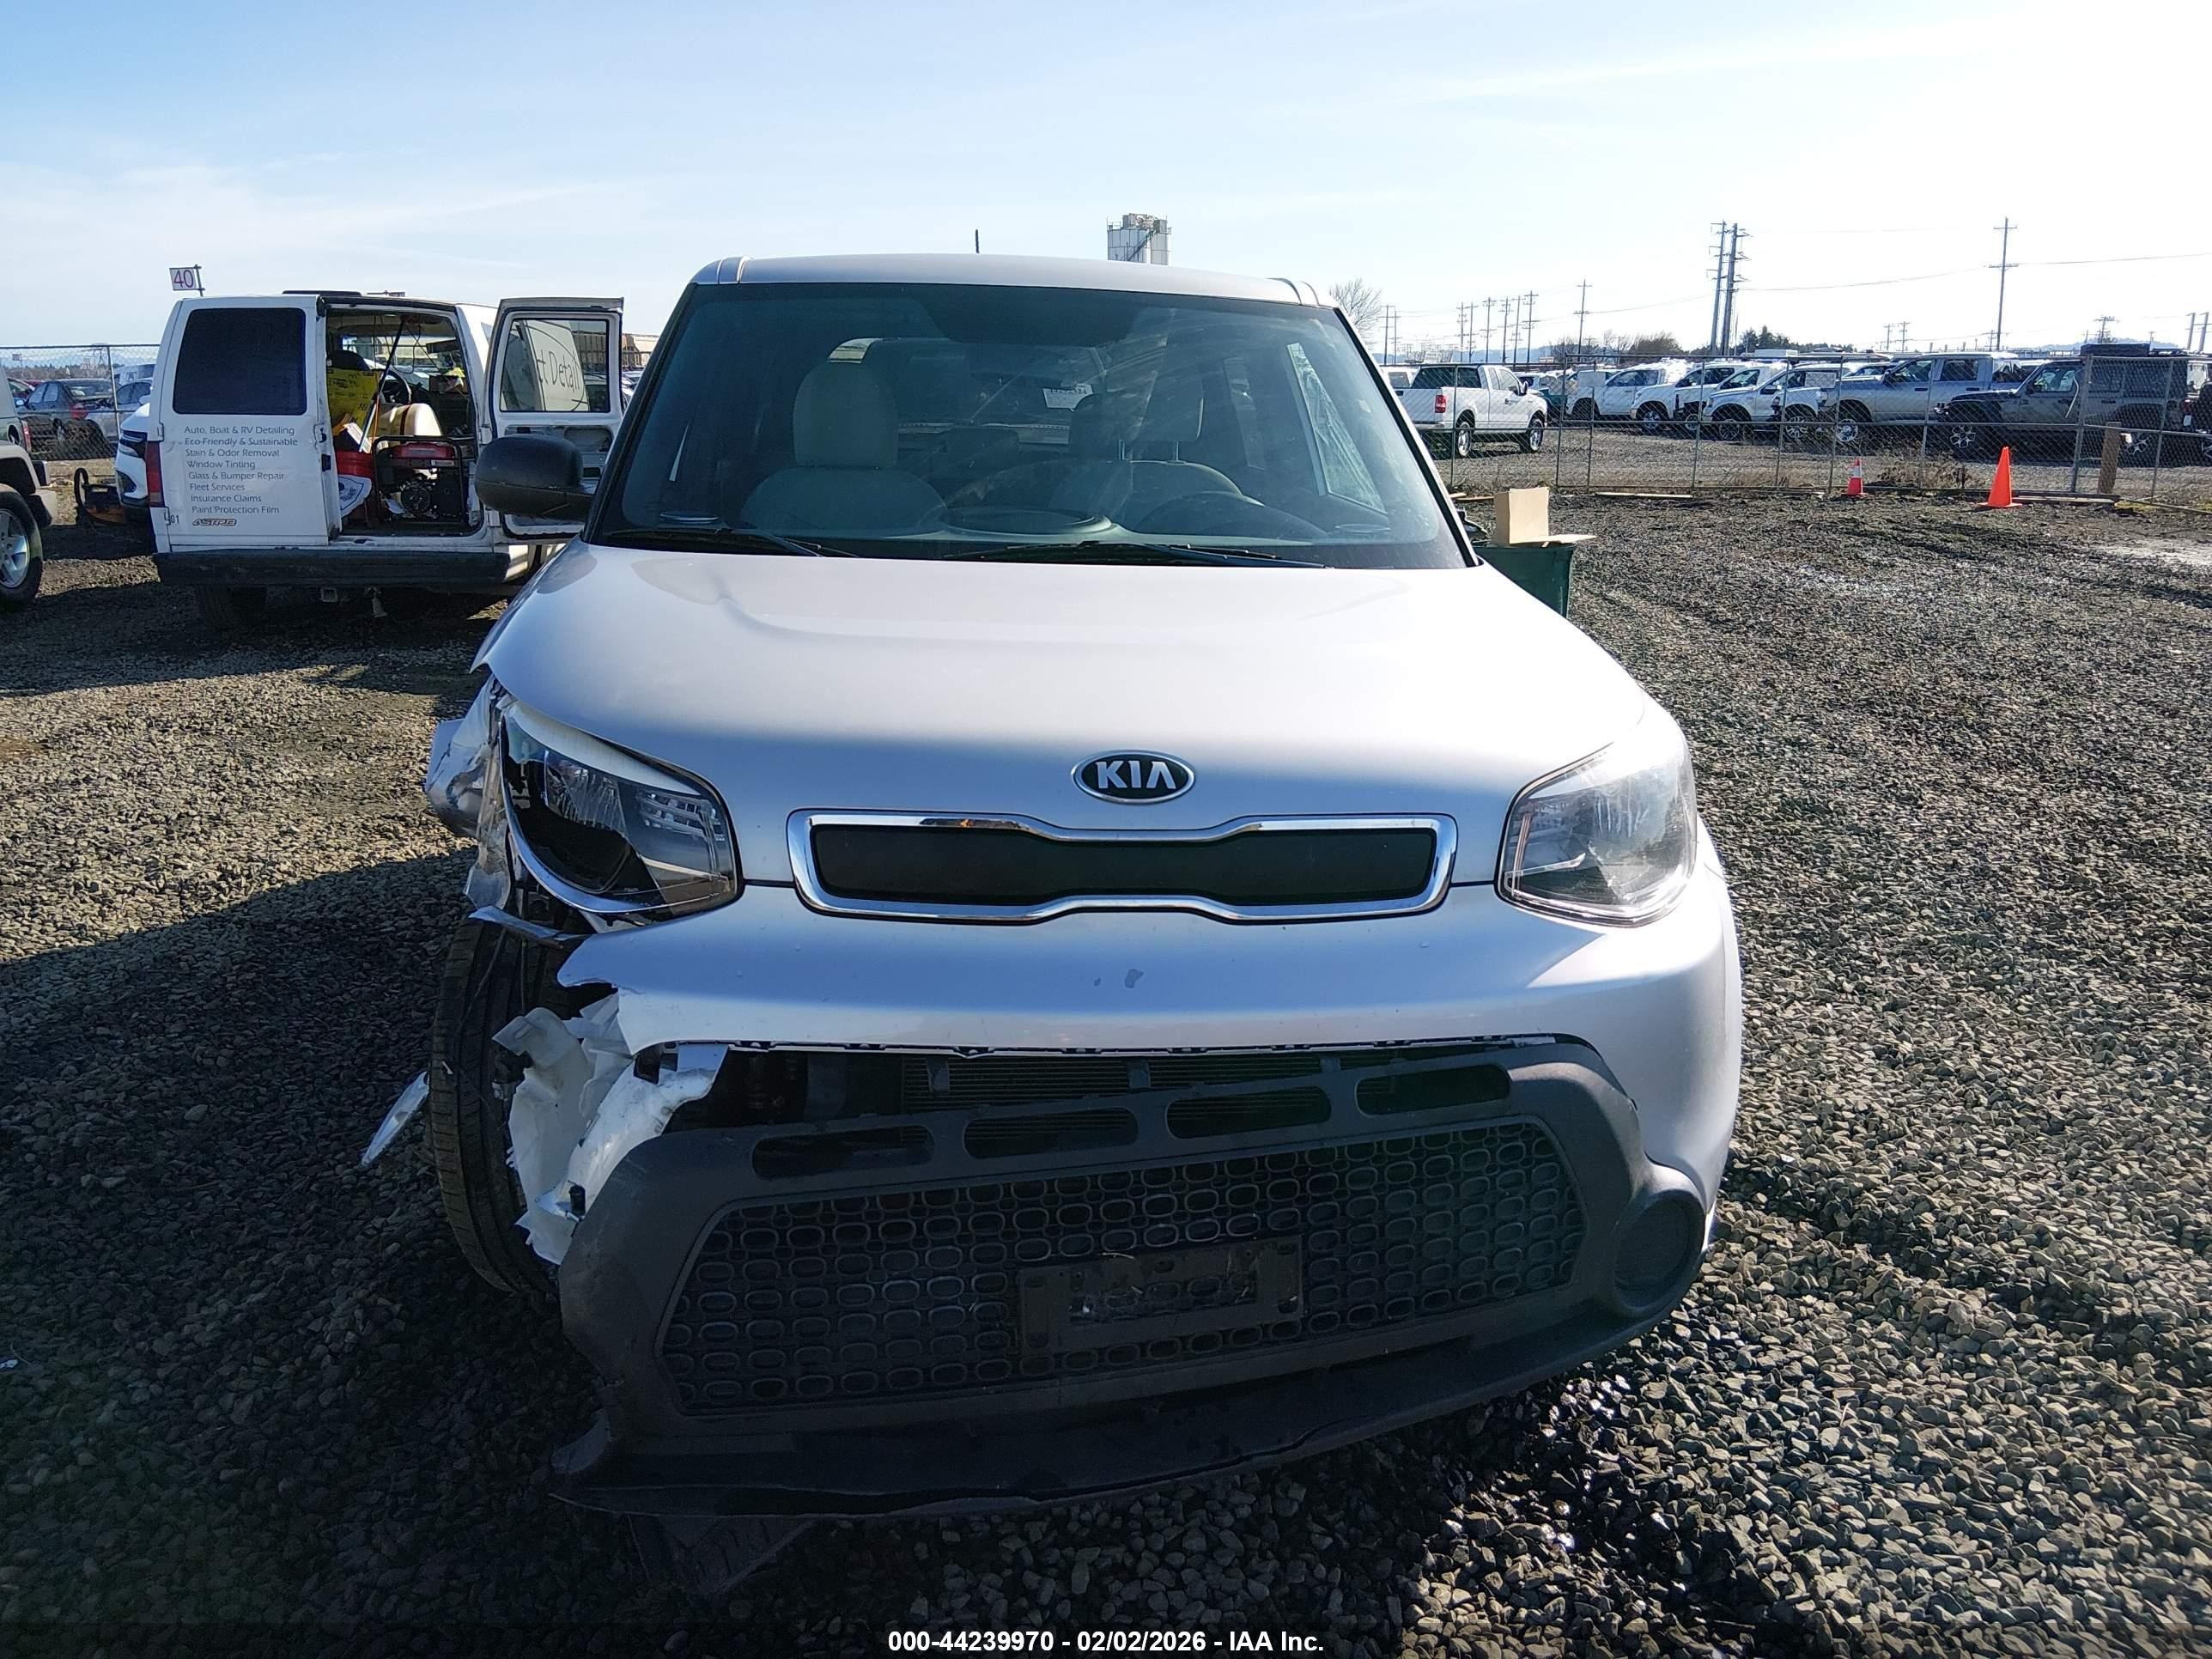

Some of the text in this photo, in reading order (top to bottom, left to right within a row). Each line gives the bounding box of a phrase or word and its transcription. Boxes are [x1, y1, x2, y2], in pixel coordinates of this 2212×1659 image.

[173, 269, 194, 289] 40
[549, 350, 580, 392] Detail
[184, 426, 208, 434] Auto,
[256, 426, 295, 436] Detailing
[185, 438, 236, 447] Eco-Friendly
[226, 460, 256, 470] Tinting
[221, 472, 255, 482] Bumper
[258, 472, 285, 482] Repair
[190, 483, 246, 491] Fleet Services
[191, 518, 238, 526] ASTRO
[1095, 760, 1176, 789] KIA
